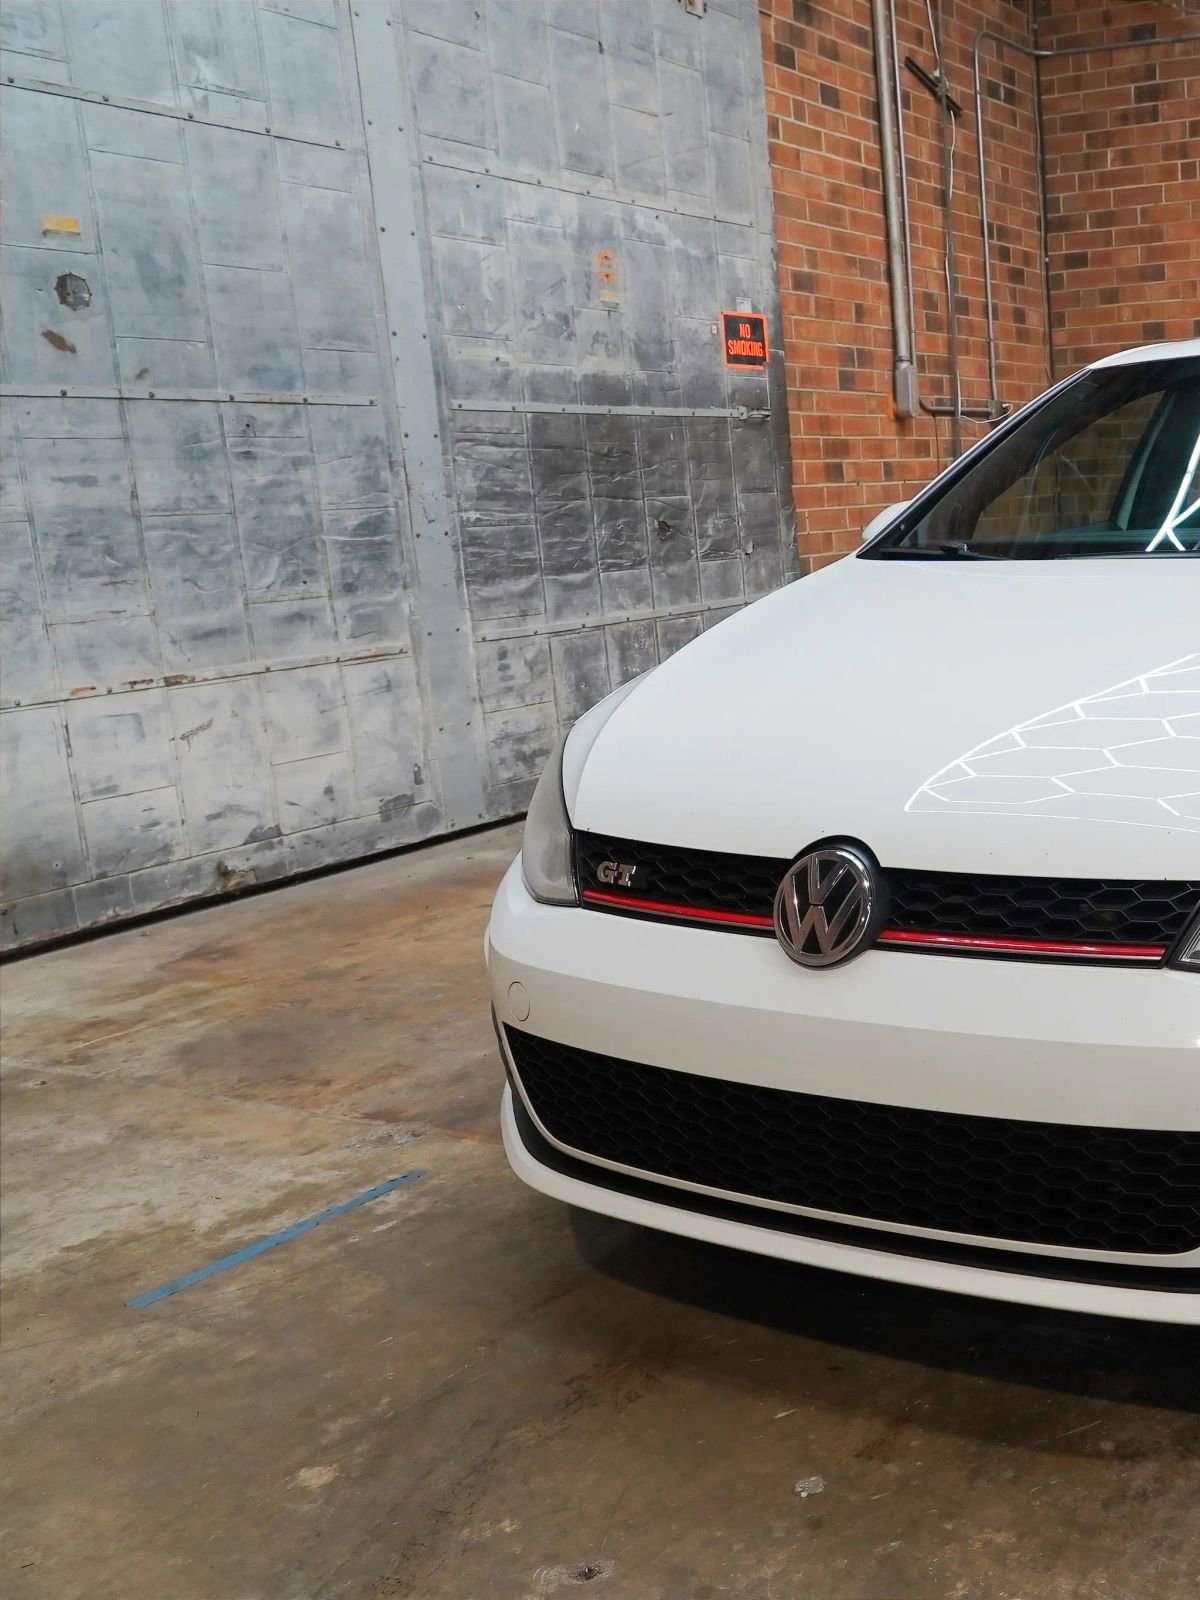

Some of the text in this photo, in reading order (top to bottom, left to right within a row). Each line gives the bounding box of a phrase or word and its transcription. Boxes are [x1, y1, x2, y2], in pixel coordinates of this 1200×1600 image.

[739, 323, 751, 338] NO
[728, 340, 763, 356] SMOKING
[778, 851, 868, 959] VW
